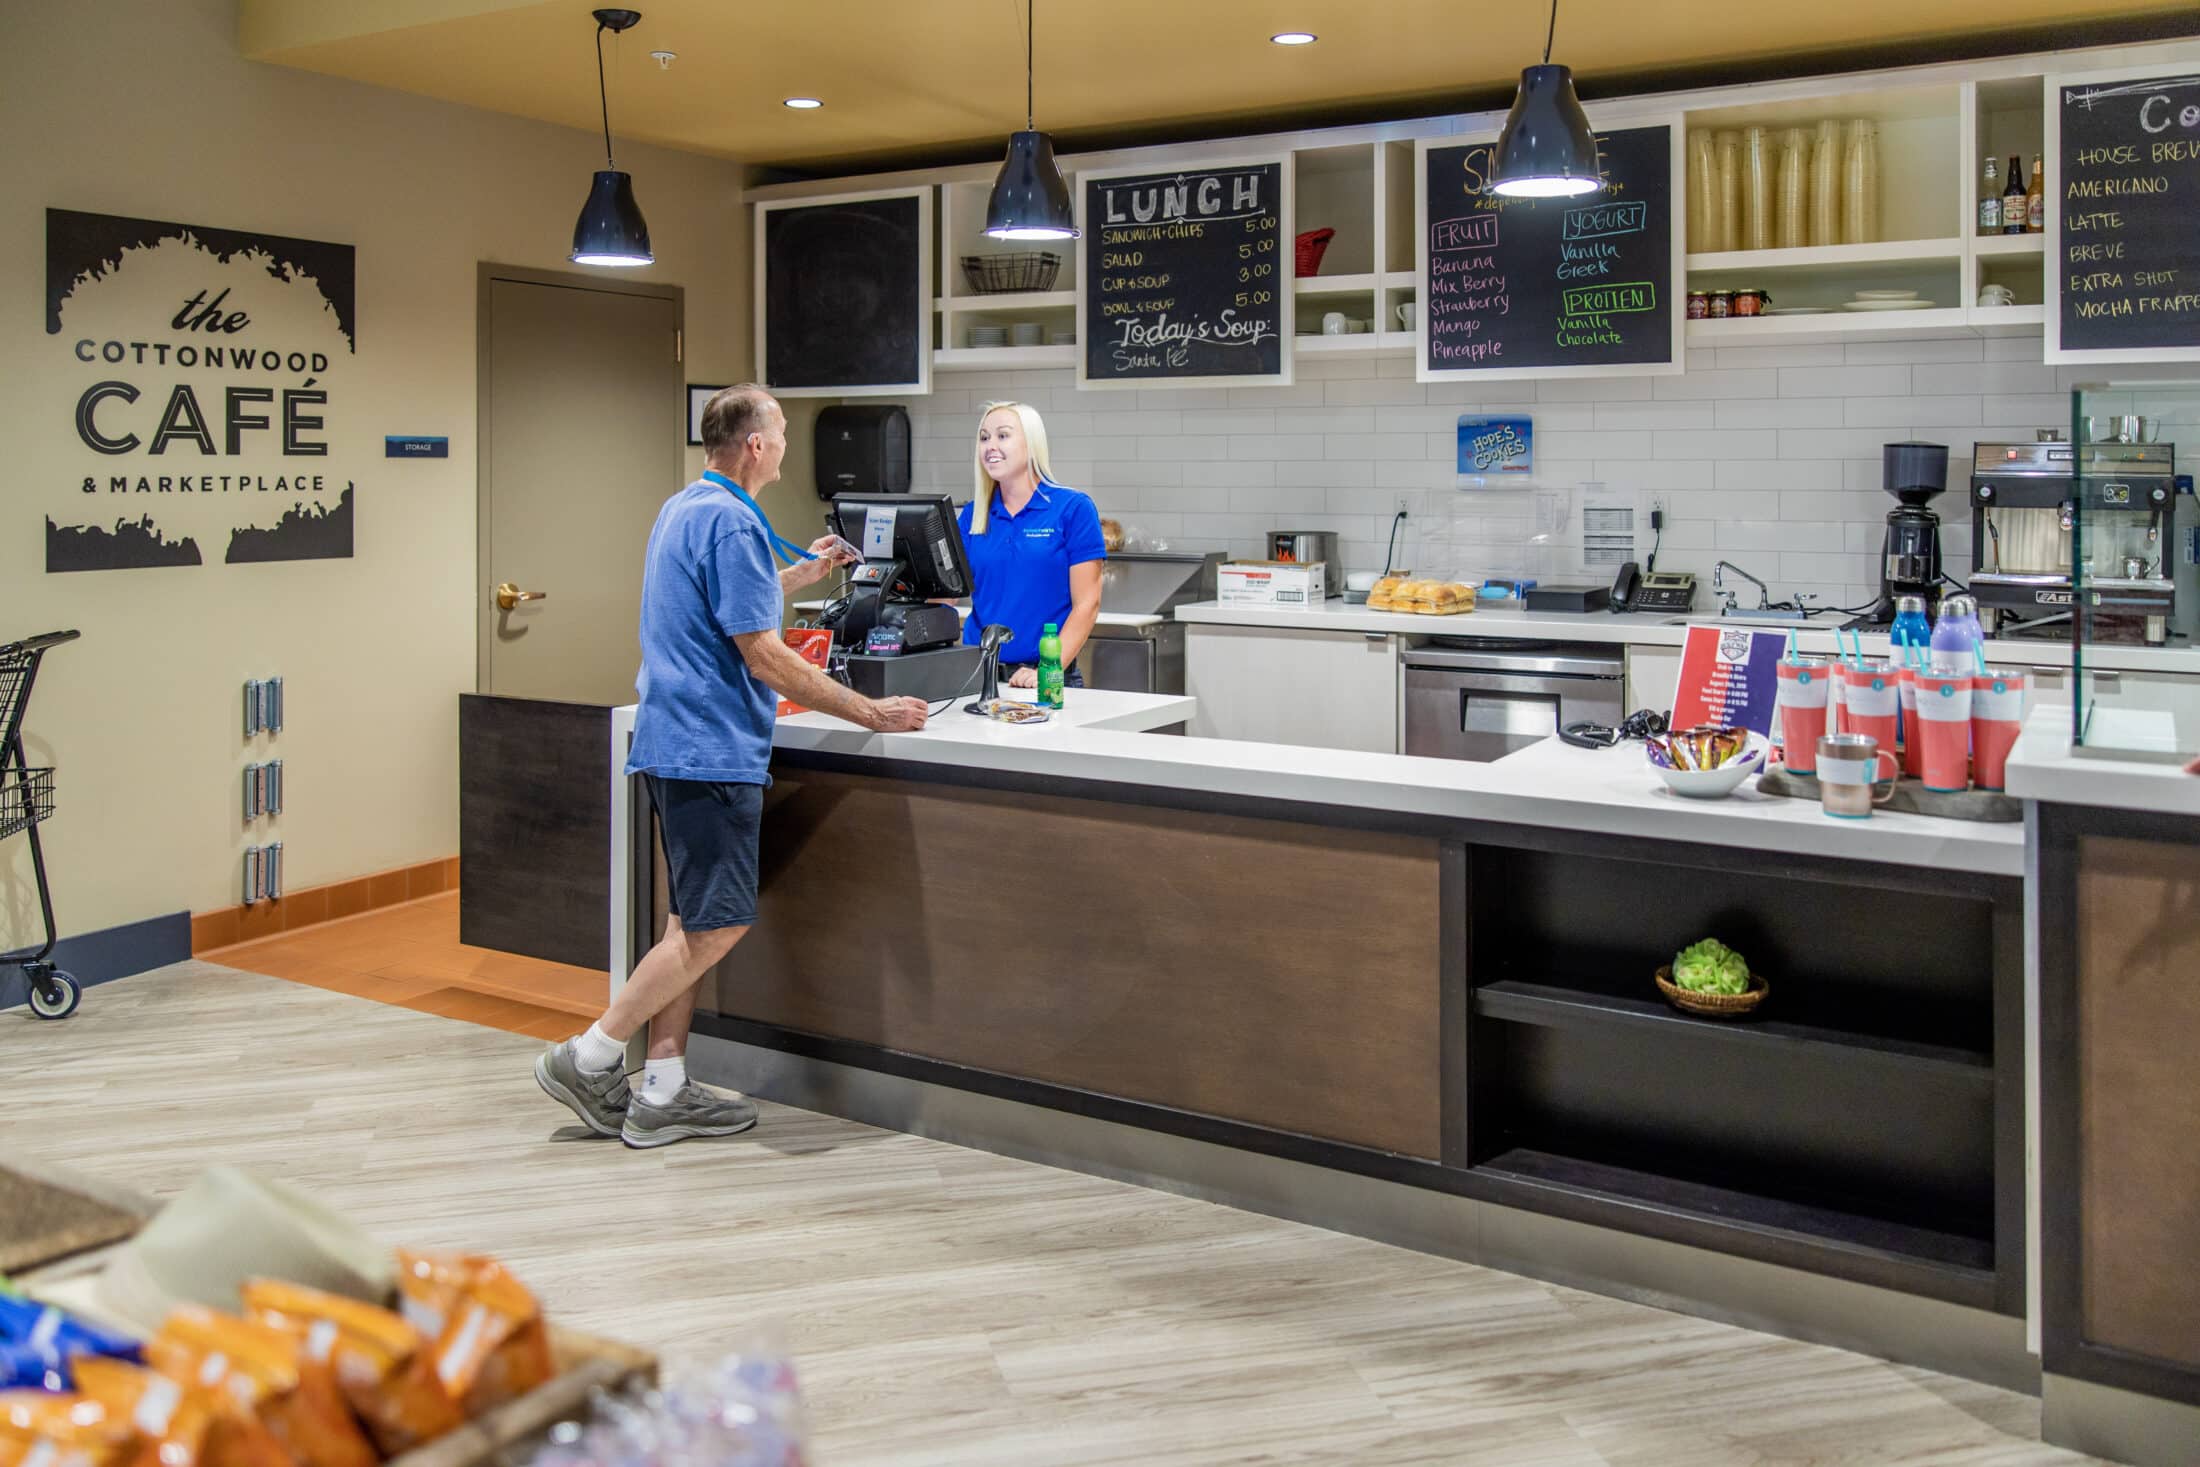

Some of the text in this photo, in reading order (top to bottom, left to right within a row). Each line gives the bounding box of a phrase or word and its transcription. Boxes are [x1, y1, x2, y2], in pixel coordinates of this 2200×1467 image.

[2077, 145, 2141, 166] HOUSE
[2068, 176, 2168, 199] AMERICANO
[1107, 176, 1258, 222] LUNCH
[1246, 217, 1276, 233] 5.00
[1570, 207, 1642, 239] YOGURT
[2069, 212, 2124, 231] LATTE
[1437, 220, 1495, 248] FRUIT
[1103, 240, 1274, 269] SALAD 5.00
[1561, 243, 1621, 262] Vanilla
[2070, 242, 2125, 262] BREVE
[1137, 273, 1170, 289] SOUP
[1239, 264, 1272, 282] 3.00
[1432, 256, 1495, 276] Banana
[1557, 260, 1609, 280] Greek
[1432, 275, 1505, 294] Mix Berry
[2071, 270, 2179, 291] EXTRA SHOT
[1236, 291, 1271, 307] 5.00
[2075, 297, 2133, 319] MOCHA
[171, 288, 250, 333] the
[1115, 313, 1210, 347] Today's
[1433, 319, 1480, 338] Mango
[1557, 315, 1611, 332] Vanilla
[1557, 330, 1623, 348] Chocolate
[75, 339, 328, 373] COTTONWOOD
[1112, 350, 1160, 372] Santa
[1433, 339, 1503, 362] Pineapple
[75, 377, 328, 456] CAFÉ
[405, 443, 431, 451] STORAGE
[82, 475, 324, 493] & MARKETPLACE
